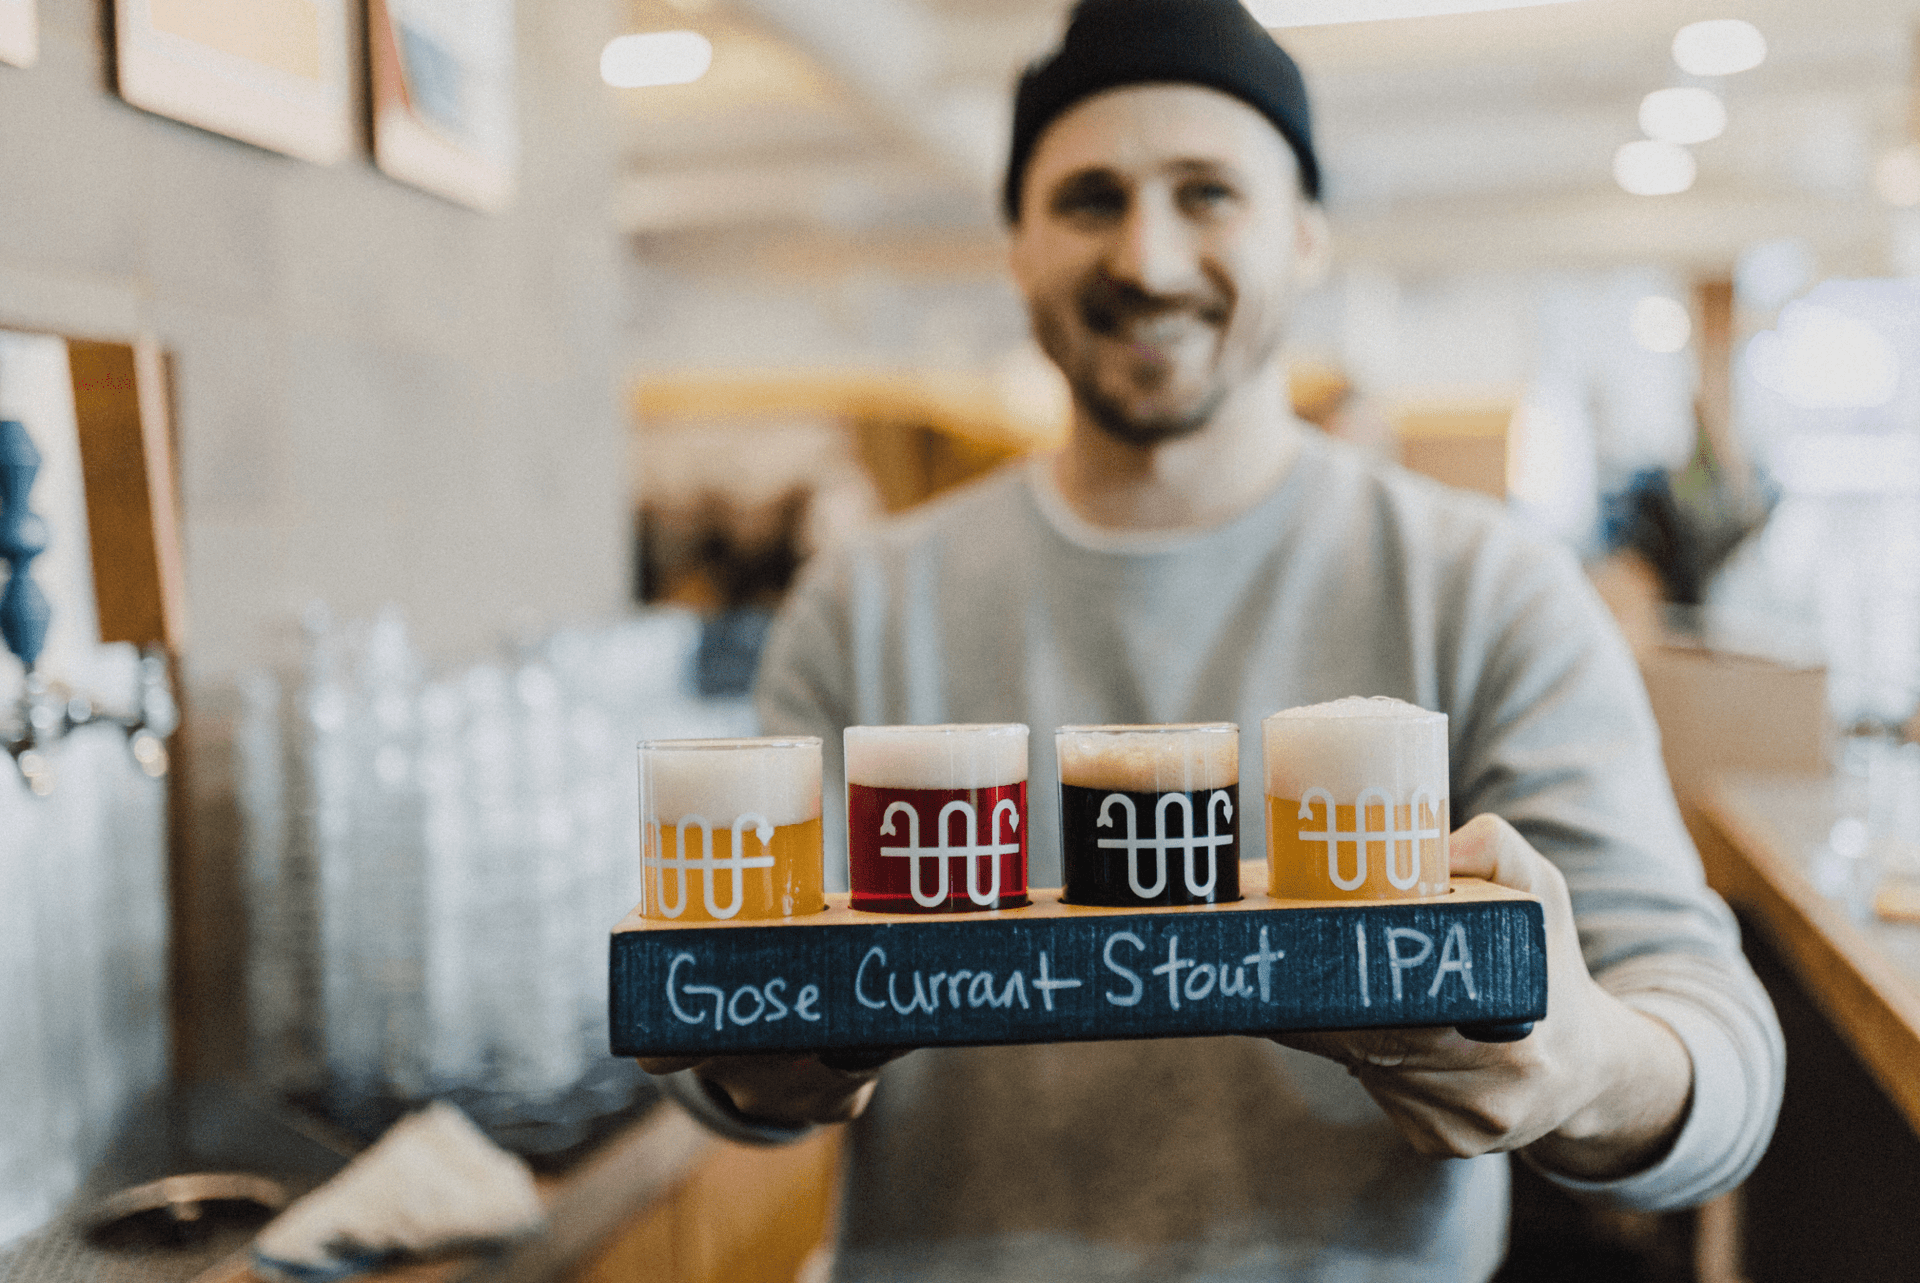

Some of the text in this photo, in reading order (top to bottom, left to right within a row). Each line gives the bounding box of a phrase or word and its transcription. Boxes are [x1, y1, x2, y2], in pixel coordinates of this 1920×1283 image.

[666, 921, 1477, 1031] Gose Currant Stout IPA
